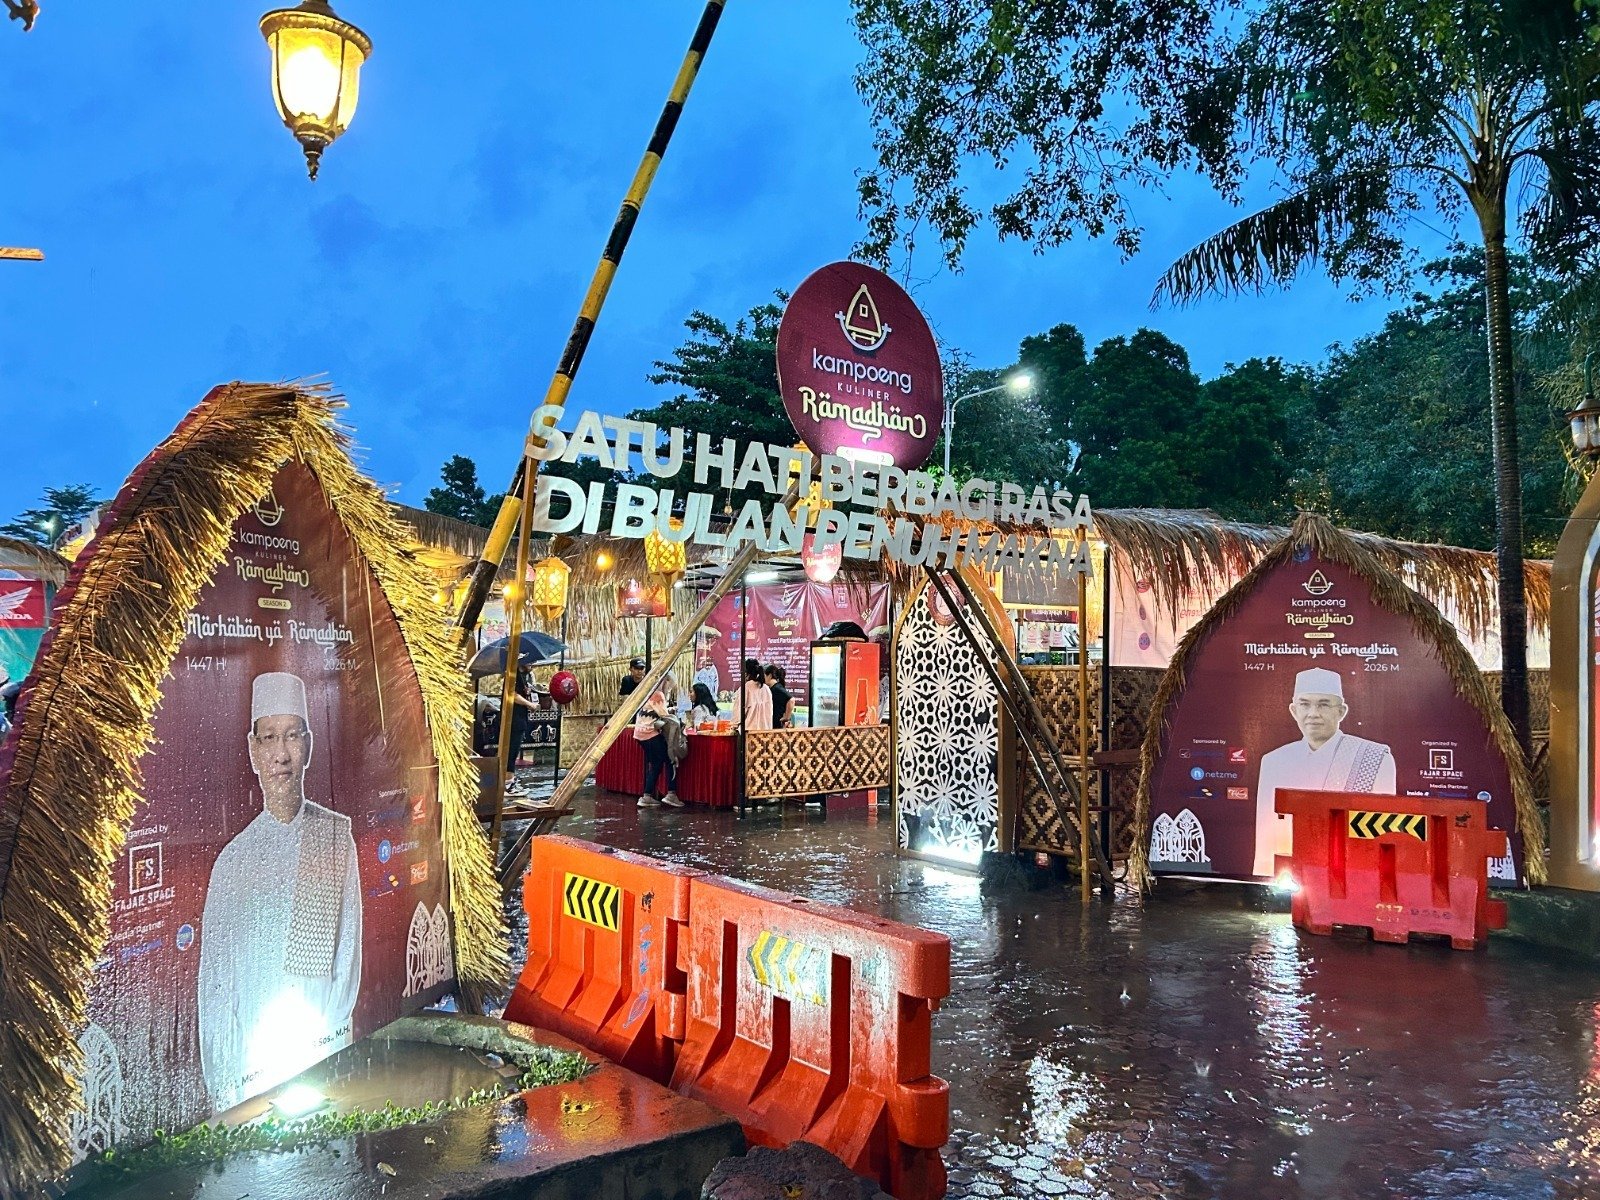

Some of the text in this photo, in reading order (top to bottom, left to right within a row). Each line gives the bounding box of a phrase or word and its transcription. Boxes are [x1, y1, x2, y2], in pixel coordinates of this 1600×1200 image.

[812, 347, 912, 394] kampoeng
[837, 383, 891, 401] KULINER
[525, 404, 1094, 533] SATU HATI BERBAGI RASA
[532, 474, 1094, 579] DI BULAN PENUH MAKNA
[240, 527, 300, 555] kampoeng
[255, 551, 287, 562] KULINER
[1291, 598, 1346, 608] kampoeng
[185, 656, 226, 671] 1447 H
[323, 658, 346, 671] 2026
[1244, 663, 1275, 671] 1447 H
[1364, 663, 1400, 672] 2026 M
[1205, 770, 1237, 778] netzme
[122, 824, 168, 840] rganized by
[114, 893, 145, 913] FAJAR
[147, 886, 176, 903] SPACE
[335, 1024, 351, 1039] M.H.
